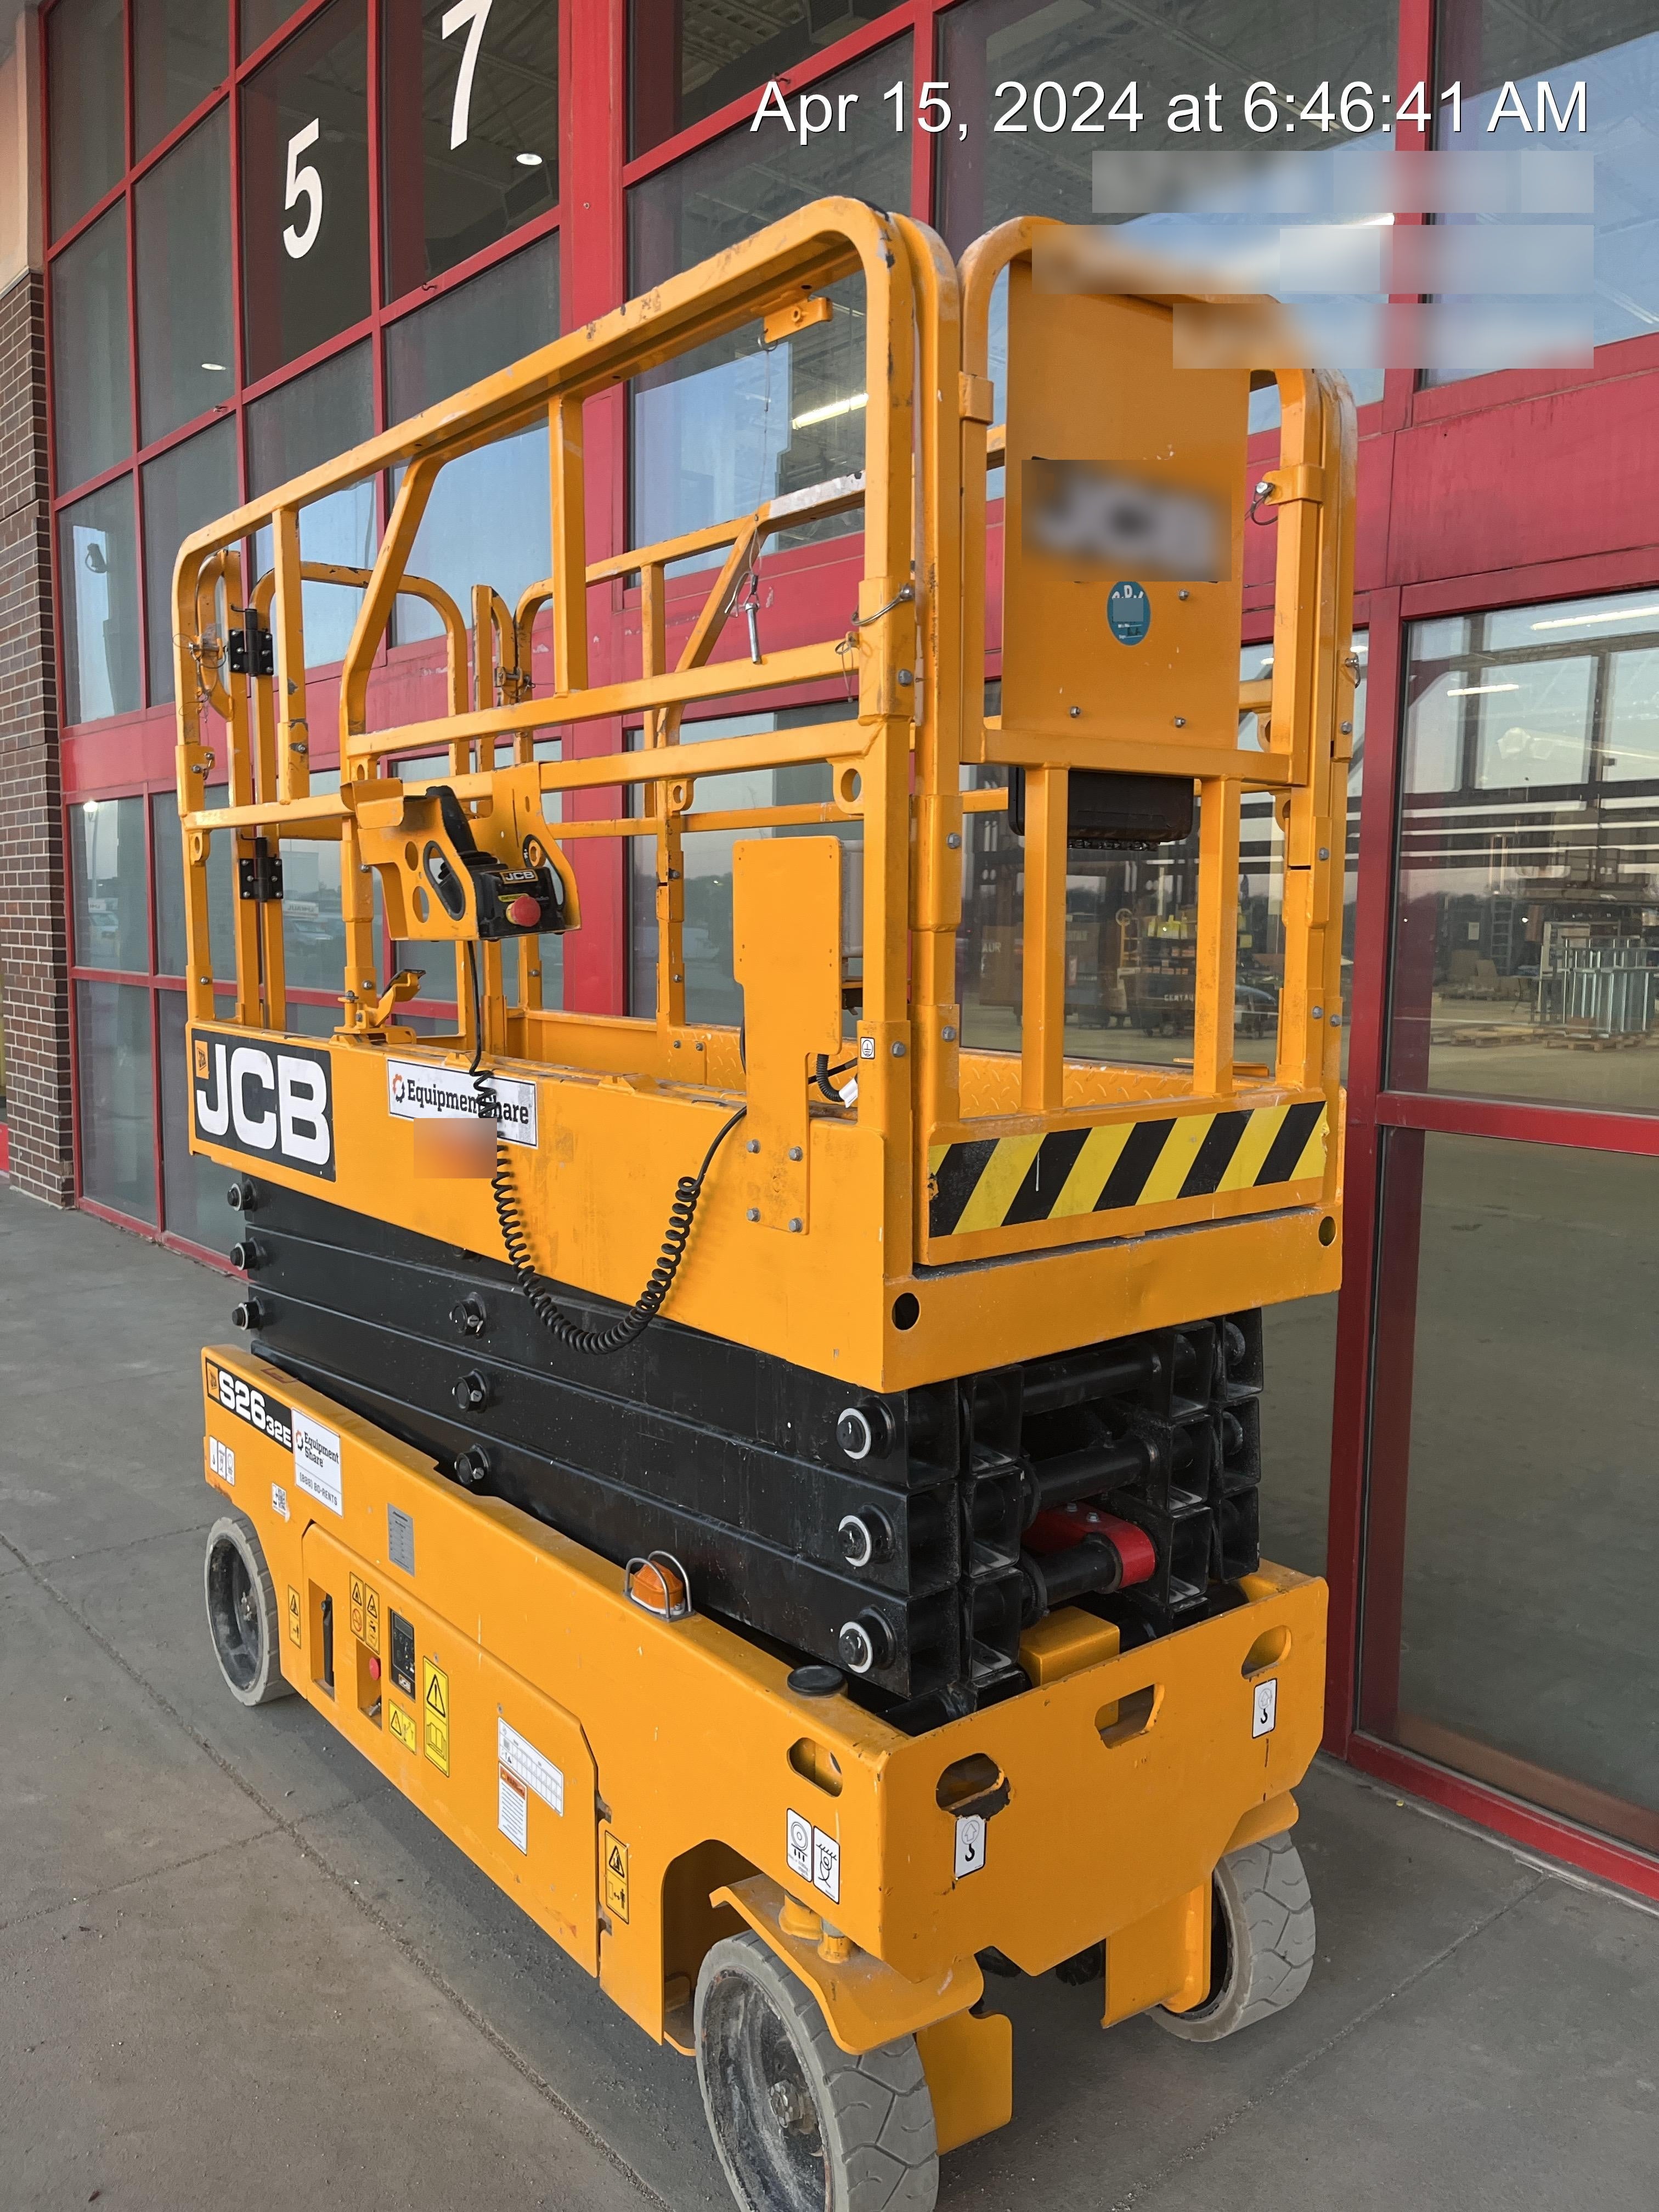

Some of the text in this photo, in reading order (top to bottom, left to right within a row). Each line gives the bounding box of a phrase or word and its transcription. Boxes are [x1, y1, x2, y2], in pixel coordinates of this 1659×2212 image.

[442, 0, 493, 151] 7
[283, 117, 323, 259] 5
[505, 871, 535, 881] JCB
[196, 1043, 330, 1165] JCB
[303, 1431, 340, 1465] Equipment
[304, 1446, 324, 1468] Share
